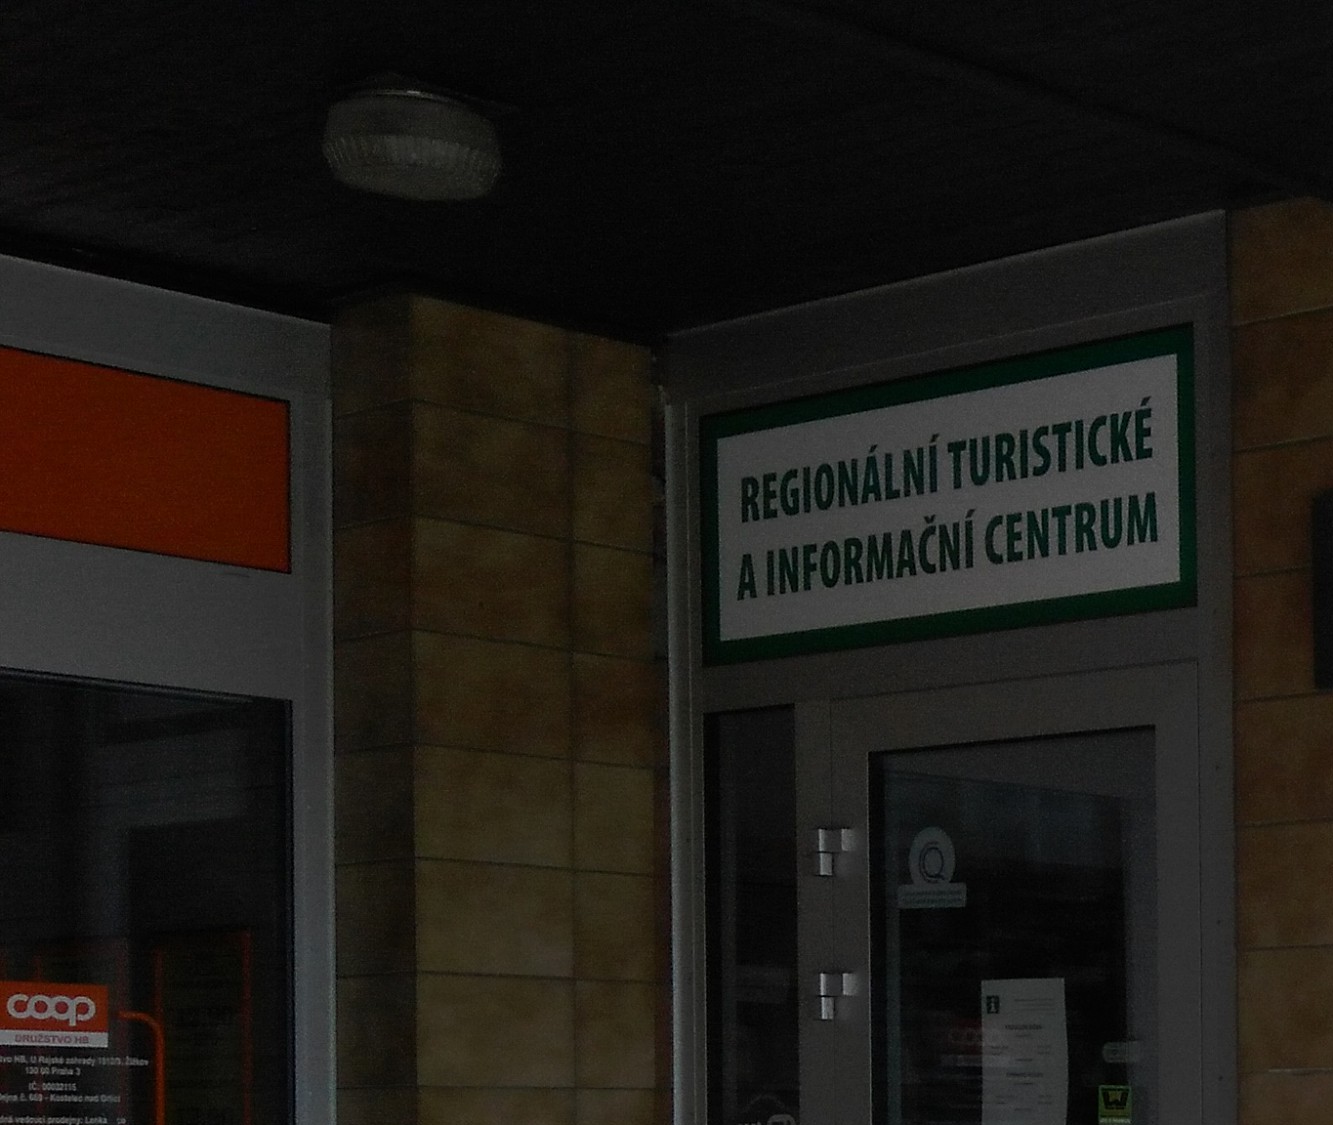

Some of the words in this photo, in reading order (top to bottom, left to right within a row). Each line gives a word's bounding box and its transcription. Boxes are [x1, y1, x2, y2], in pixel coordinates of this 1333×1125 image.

[741, 433, 940, 523] REGIONÁLNÍ
[947, 396, 1154, 489] TURISTICKÉ
[737, 554, 758, 600] A
[767, 508, 975, 597] INFORMAČNÍ
[985, 492, 1159, 566] CENTRUM
[6, 993, 96, 1027] coop
